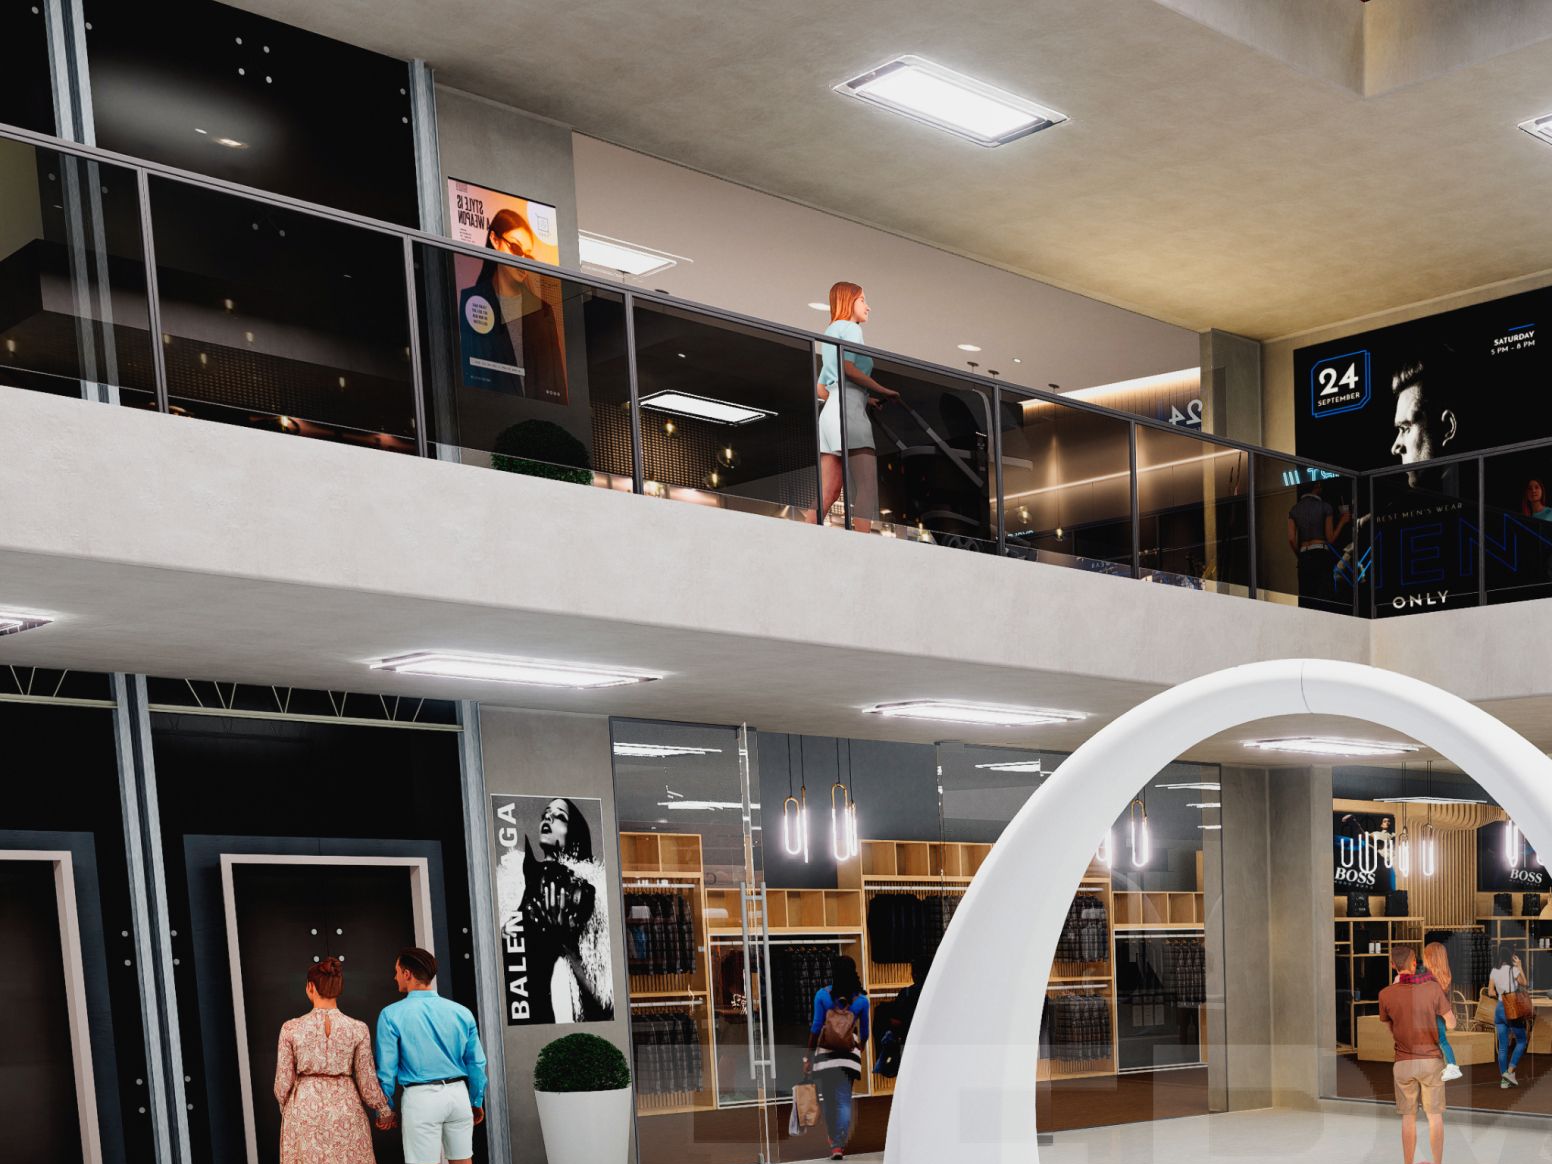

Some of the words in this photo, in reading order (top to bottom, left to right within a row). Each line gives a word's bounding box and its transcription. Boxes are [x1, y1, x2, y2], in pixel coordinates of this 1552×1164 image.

[1493, 330, 1535, 347] SATURDAY
[1497, 346, 1509, 354] PM
[1523, 340, 1536, 348] PM
[1318, 362, 1359, 396] 24
[1317, 391, 1360, 407] SEPTEMBER
[1376, 513, 1399, 524] BEST
[1403, 508, 1432, 520] MEN'S
[1436, 502, 1464, 513] WEAR
[1392, 590, 1449, 609] ONLY
[1334, 866, 1376, 886] BOSS
[1510, 868, 1543, 883] BOSS
